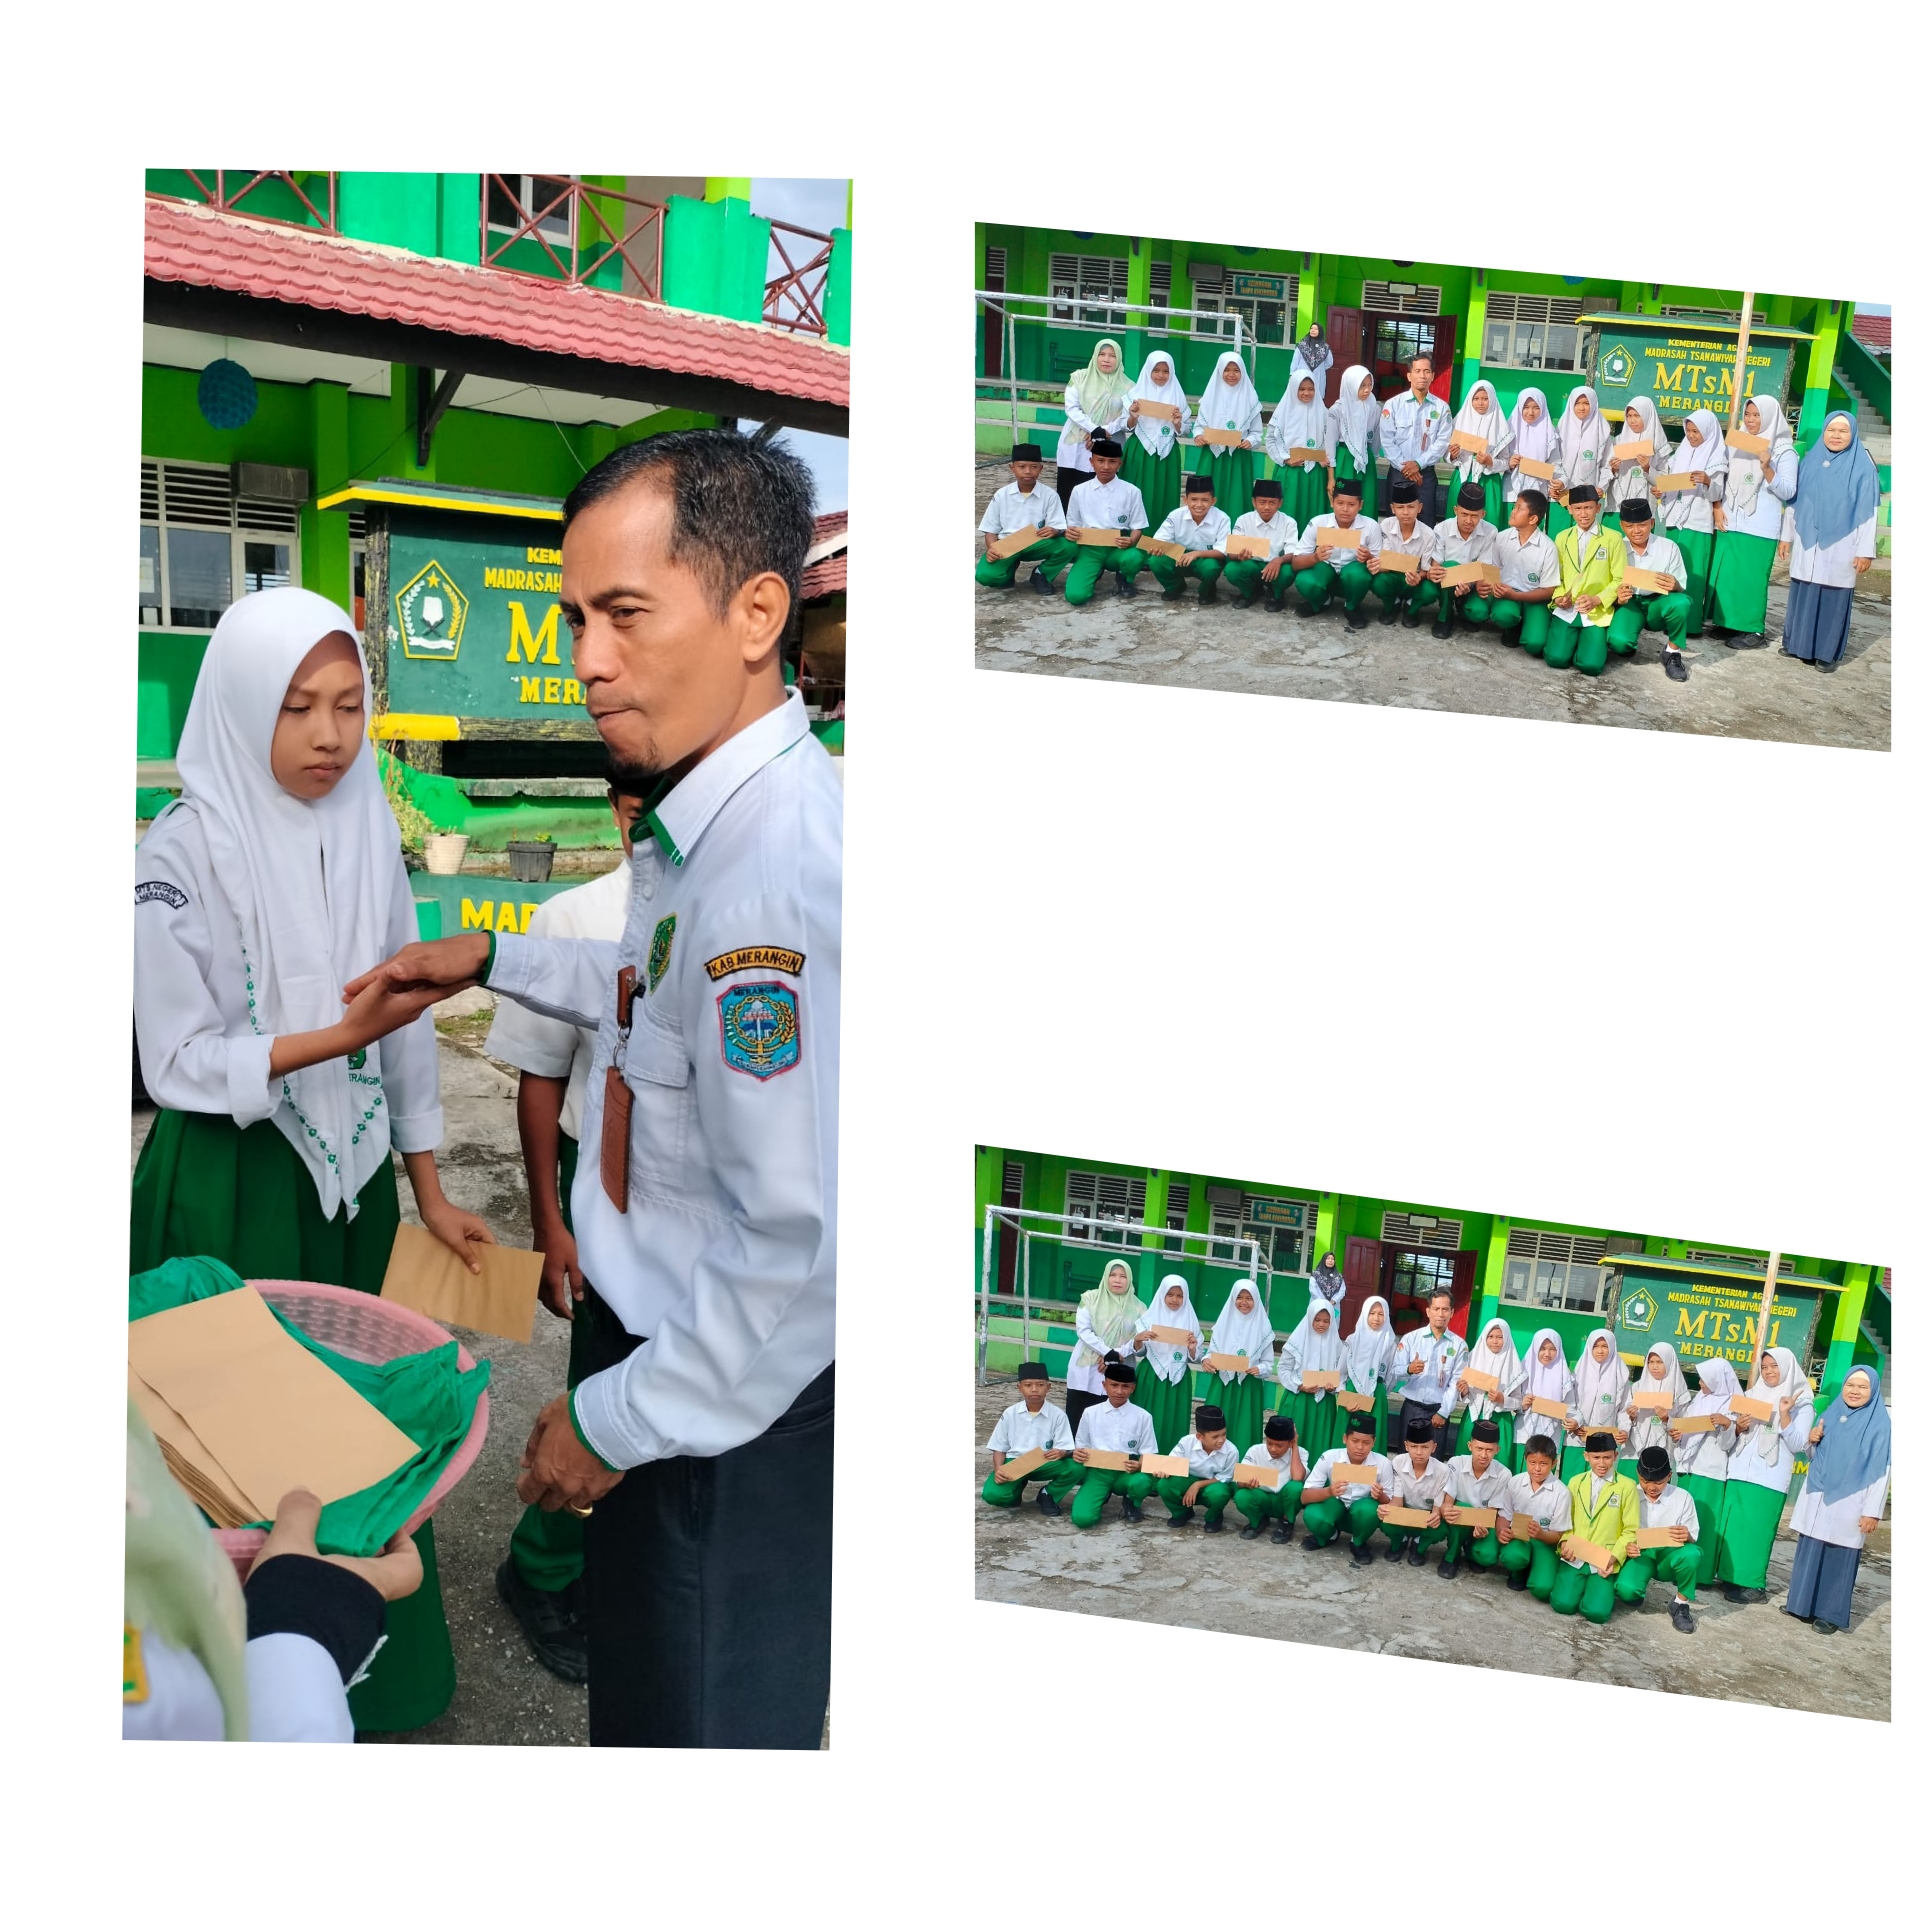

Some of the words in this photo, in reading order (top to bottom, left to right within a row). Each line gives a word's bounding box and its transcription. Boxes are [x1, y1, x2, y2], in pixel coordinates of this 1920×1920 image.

[1645, 347, 1687, 360] MADRASAH
[1668, 338, 1722, 351] KEMENTERIAN
[1727, 344, 1753, 353] AGA
[1653, 362, 1735, 396] MTsN
[1743, 371, 1755, 398] 1
[1659, 395, 1733, 414] MERANGI
[484, 567, 563, 594] MADRASAH
[520, 676, 587, 705] MER
[711, 956, 735, 975] KAB
[736, 950, 799, 972] MERANGIN
[1668, 1291, 1711, 1306] MADRASAH
[1692, 1284, 1748, 1298] KEMENTERIAN
[1752, 1291, 1779, 1302] AGA
[1674, 1307, 1760, 1345] MTsN
[1766, 1320, 1780, 1348] 1
[1680, 1341, 1754, 1363] MERANGI
